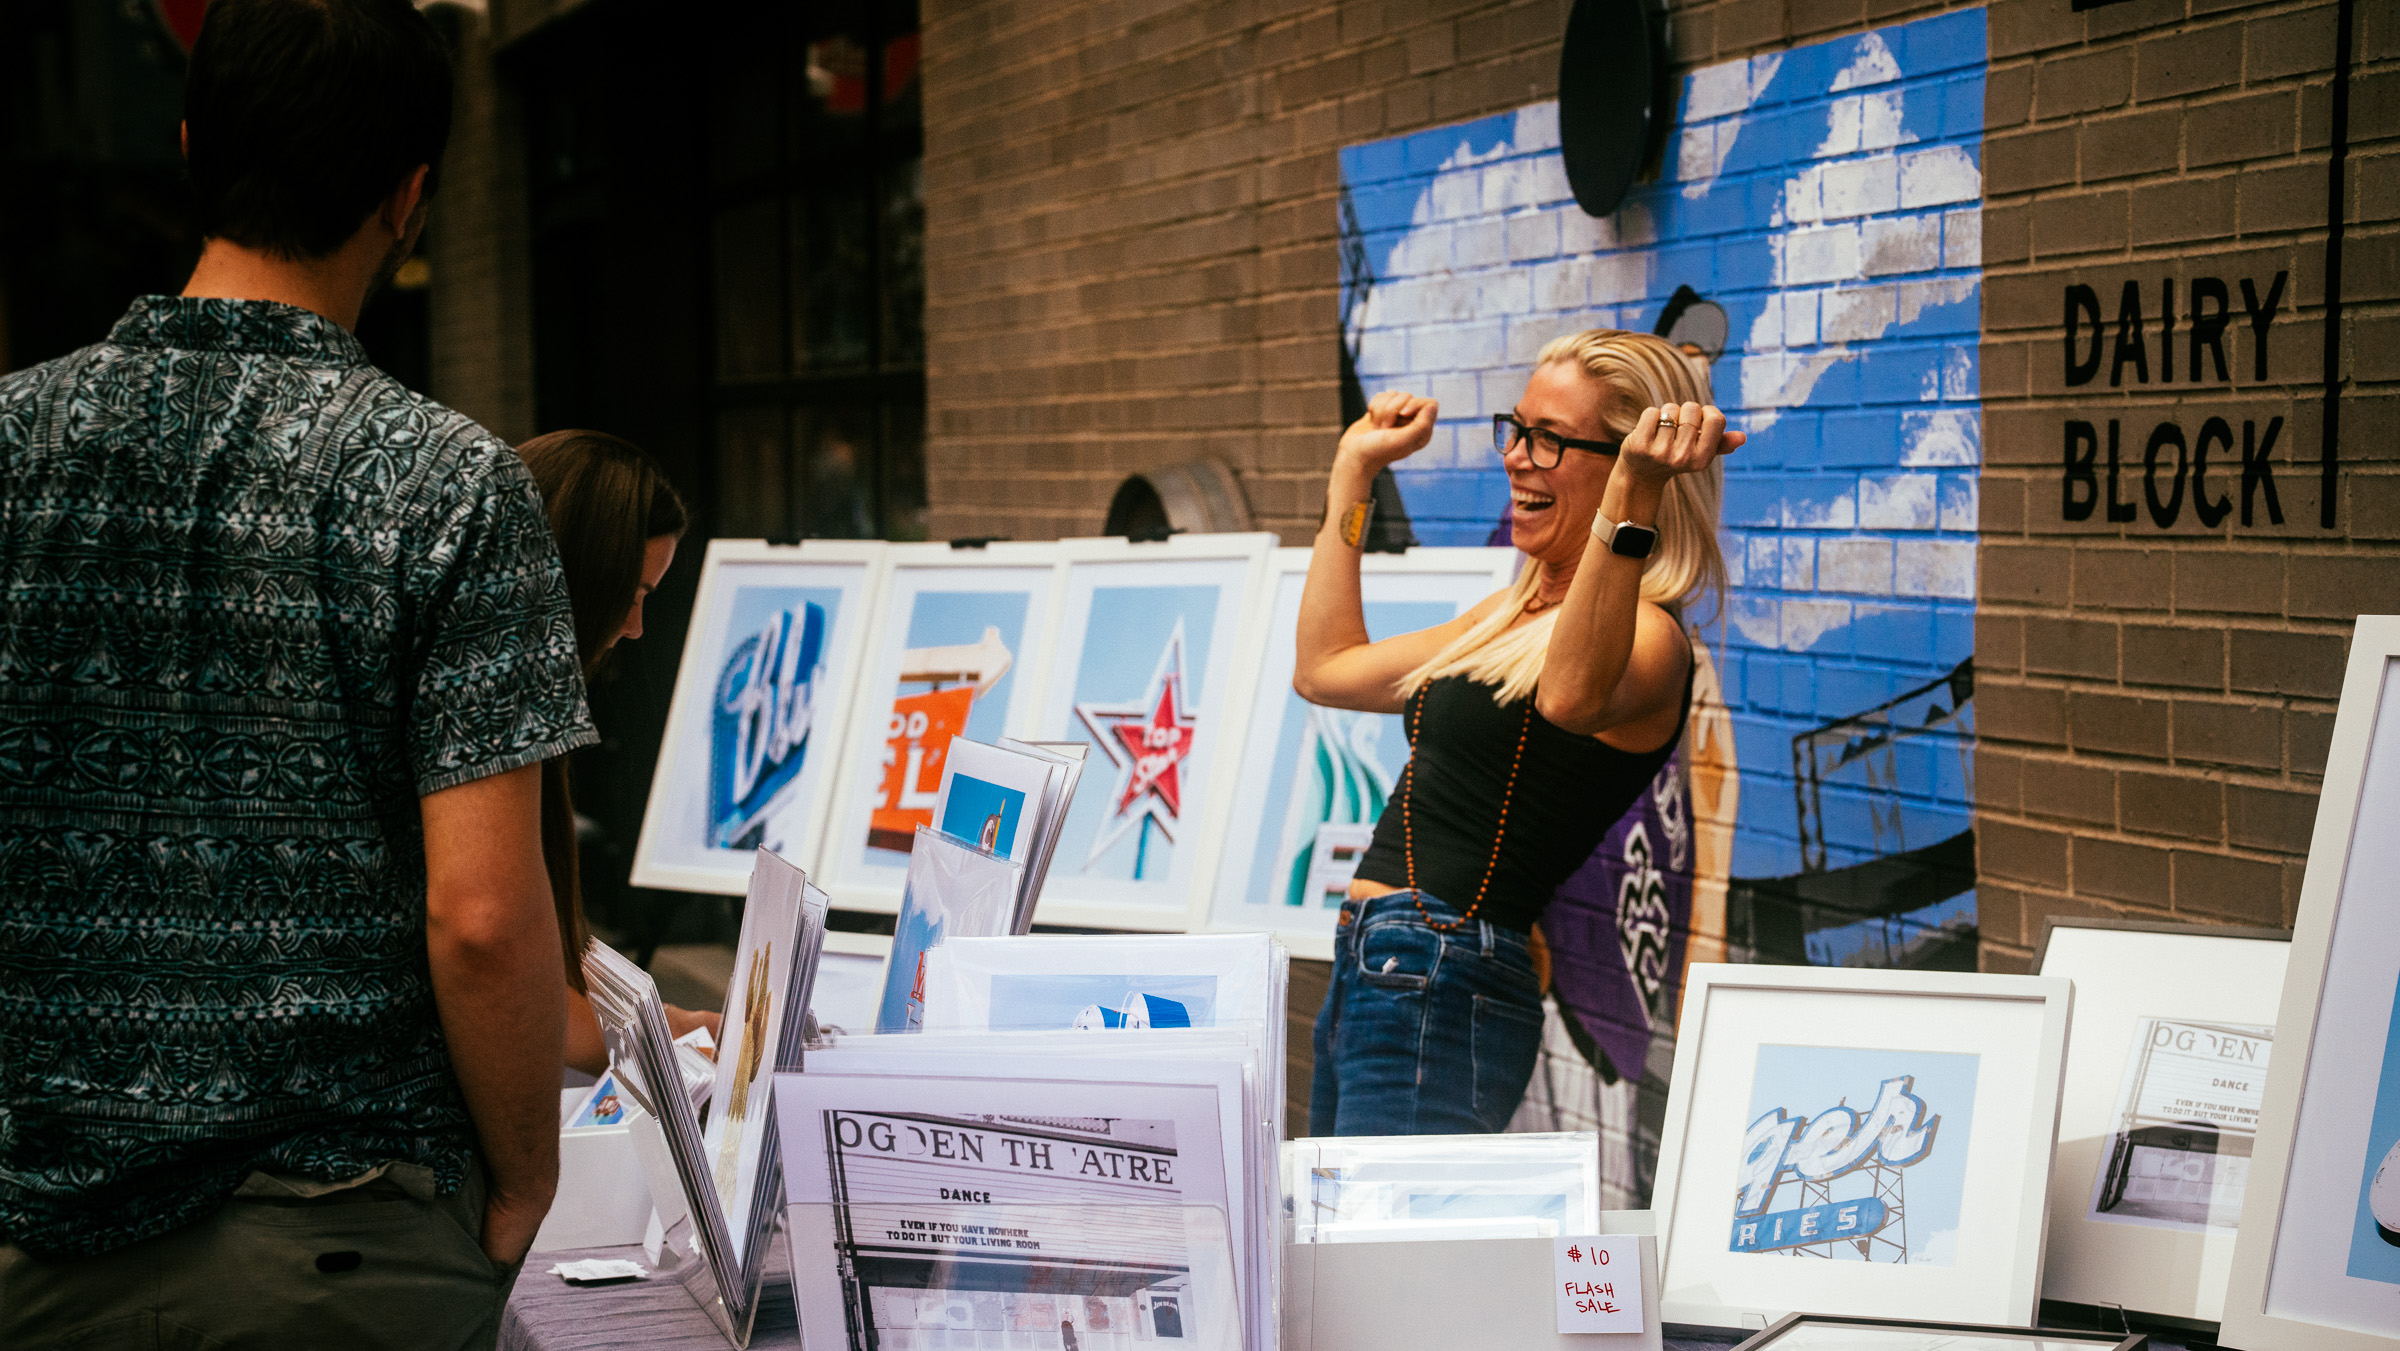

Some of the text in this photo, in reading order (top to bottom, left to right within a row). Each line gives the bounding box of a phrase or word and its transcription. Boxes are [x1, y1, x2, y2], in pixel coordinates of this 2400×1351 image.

[2063, 271, 2289, 388] DAIRY
[2062, 416, 2286, 530] BLOCK
[2211, 1077, 2250, 1092] DANCE
[2175, 1098, 2193, 1107] EVEN
[2204, 1102, 2217, 1111] YOU
[2218, 1104, 2235, 1113] HAVE
[2173, 1107, 2183, 1115] DO
[2194, 1110, 2209, 1119] BUT
[2210, 1112, 2228, 1121] YOUR
[2229, 1114, 2252, 1124] LIVING
[939, 1187, 992, 1204] DANCE
[900, 1220, 1029, 1238] EVEN IF YOU HAVE NOWHERE
[1738, 1205, 1860, 1247] RIES
[886, 1231, 1041, 1250] TO DO IT BUT YOUR LIVING ROOM
[1565, 1281, 1615, 1299] FLASH
[1575, 1298, 1622, 1314] SALE
